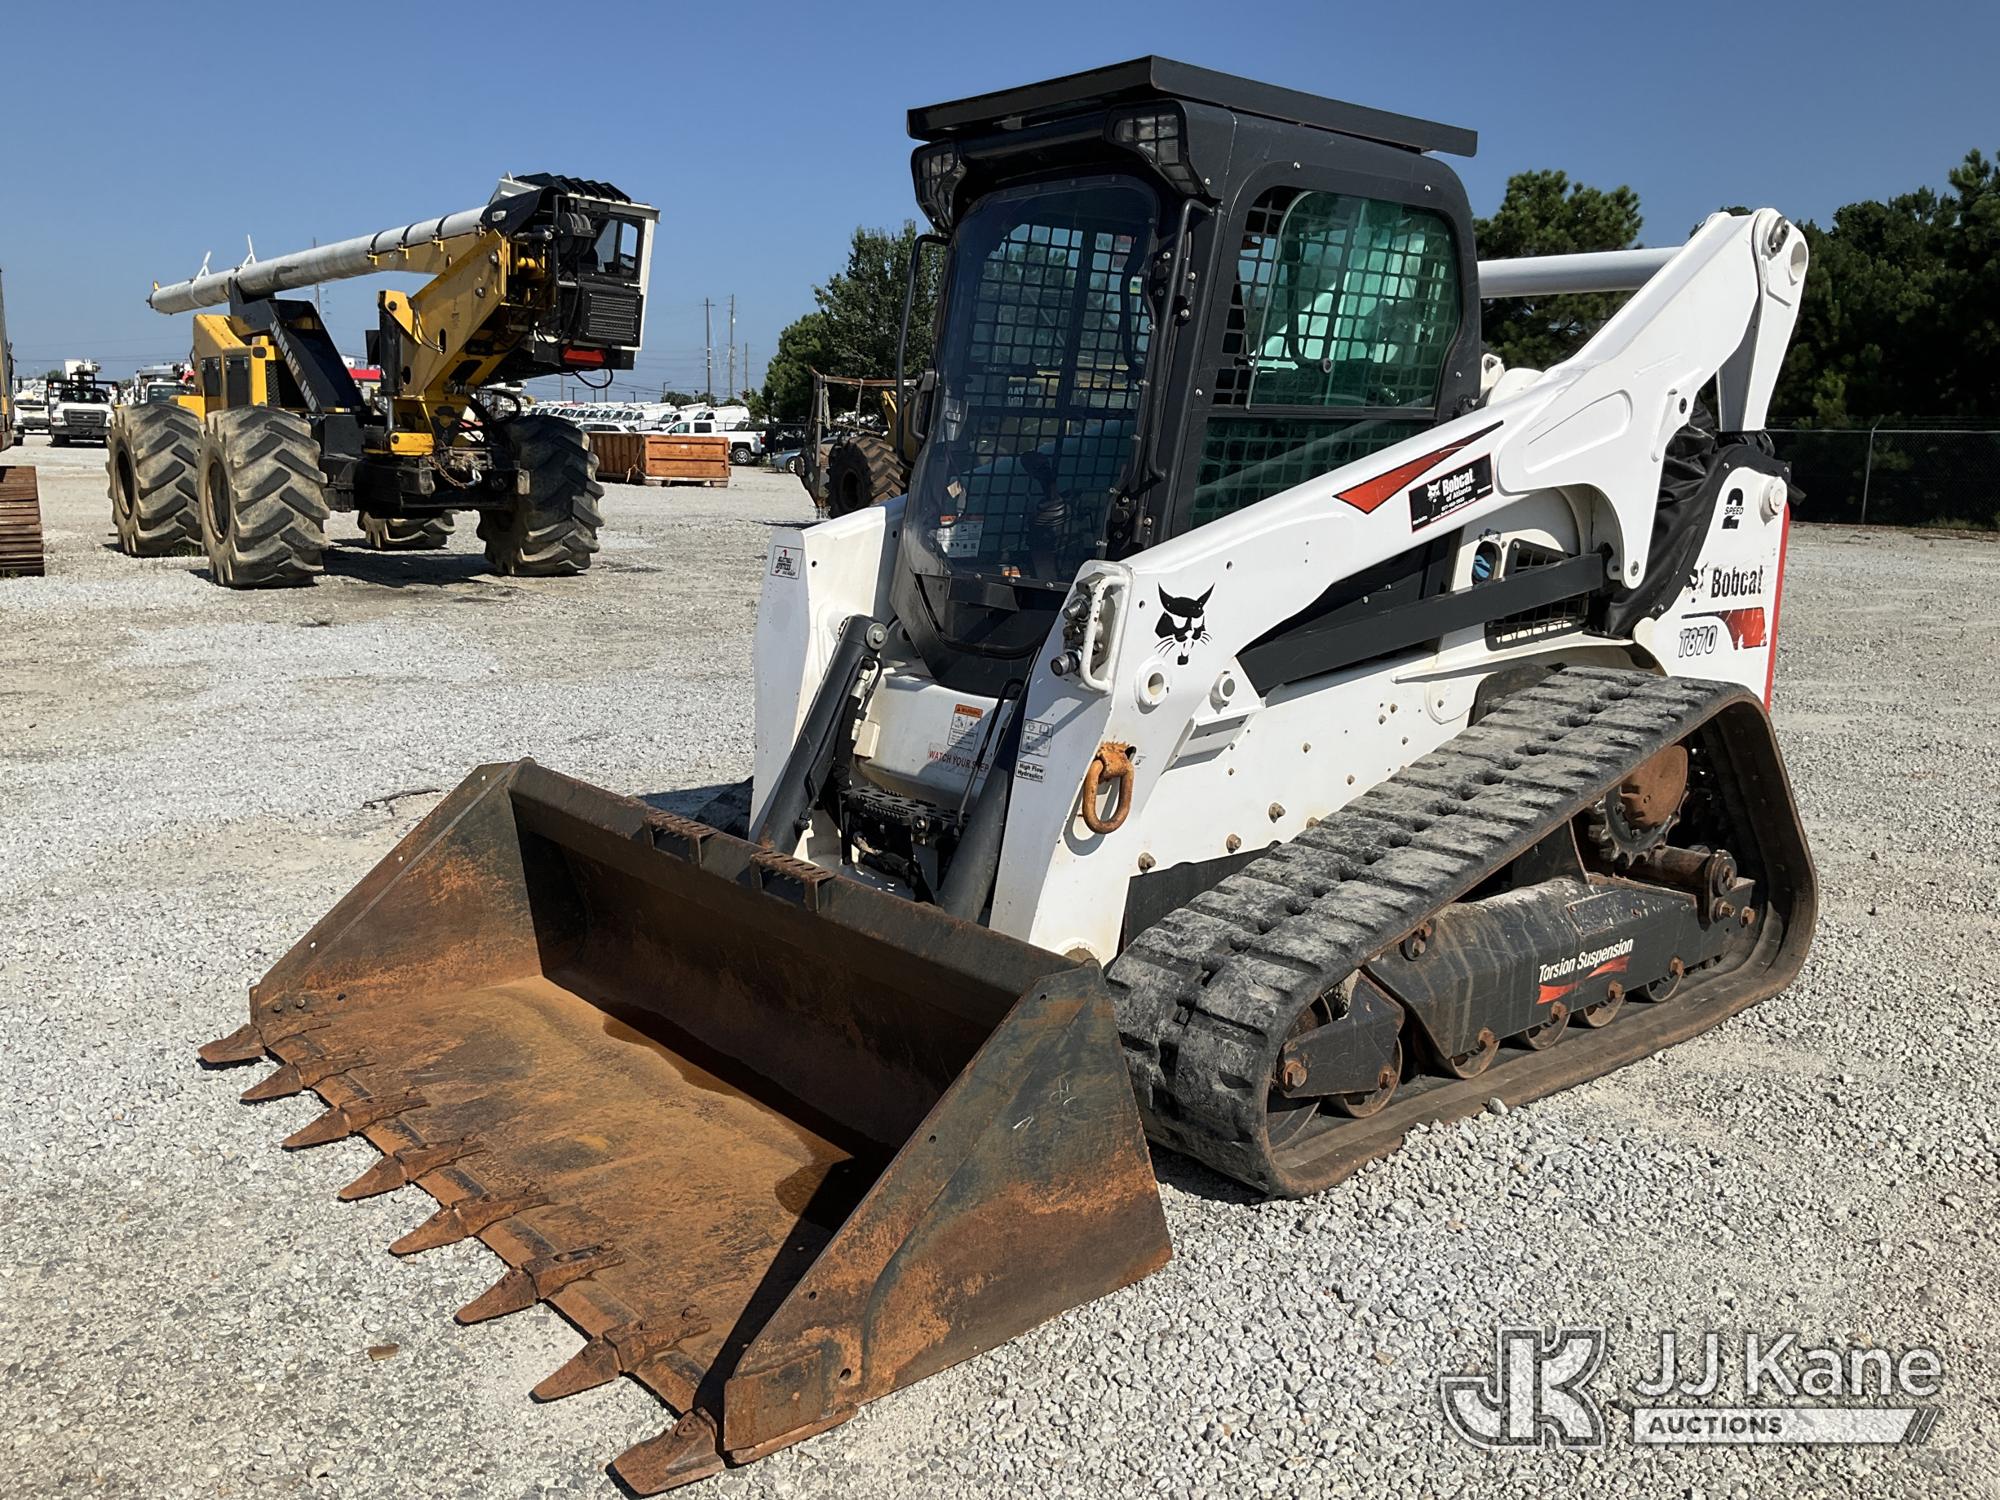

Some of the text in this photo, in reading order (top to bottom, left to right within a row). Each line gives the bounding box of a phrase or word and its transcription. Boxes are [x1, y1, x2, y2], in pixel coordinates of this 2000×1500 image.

[1441, 468, 1474, 497] Bobcat
[1445, 493, 1453, 503] of
[1721, 488, 1744, 529] 2
[1724, 506, 1744, 515] SPEED
[1710, 565, 1764, 598] Bobcat
[1678, 625, 1718, 658] T870
[928, 750, 990, 773] WATCH YOUR SEP
[1017, 768, 1044, 781] Hydraulics
[1018, 763, 1044, 774] High Flow
[1538, 938, 1634, 983] Torsion Suspension
